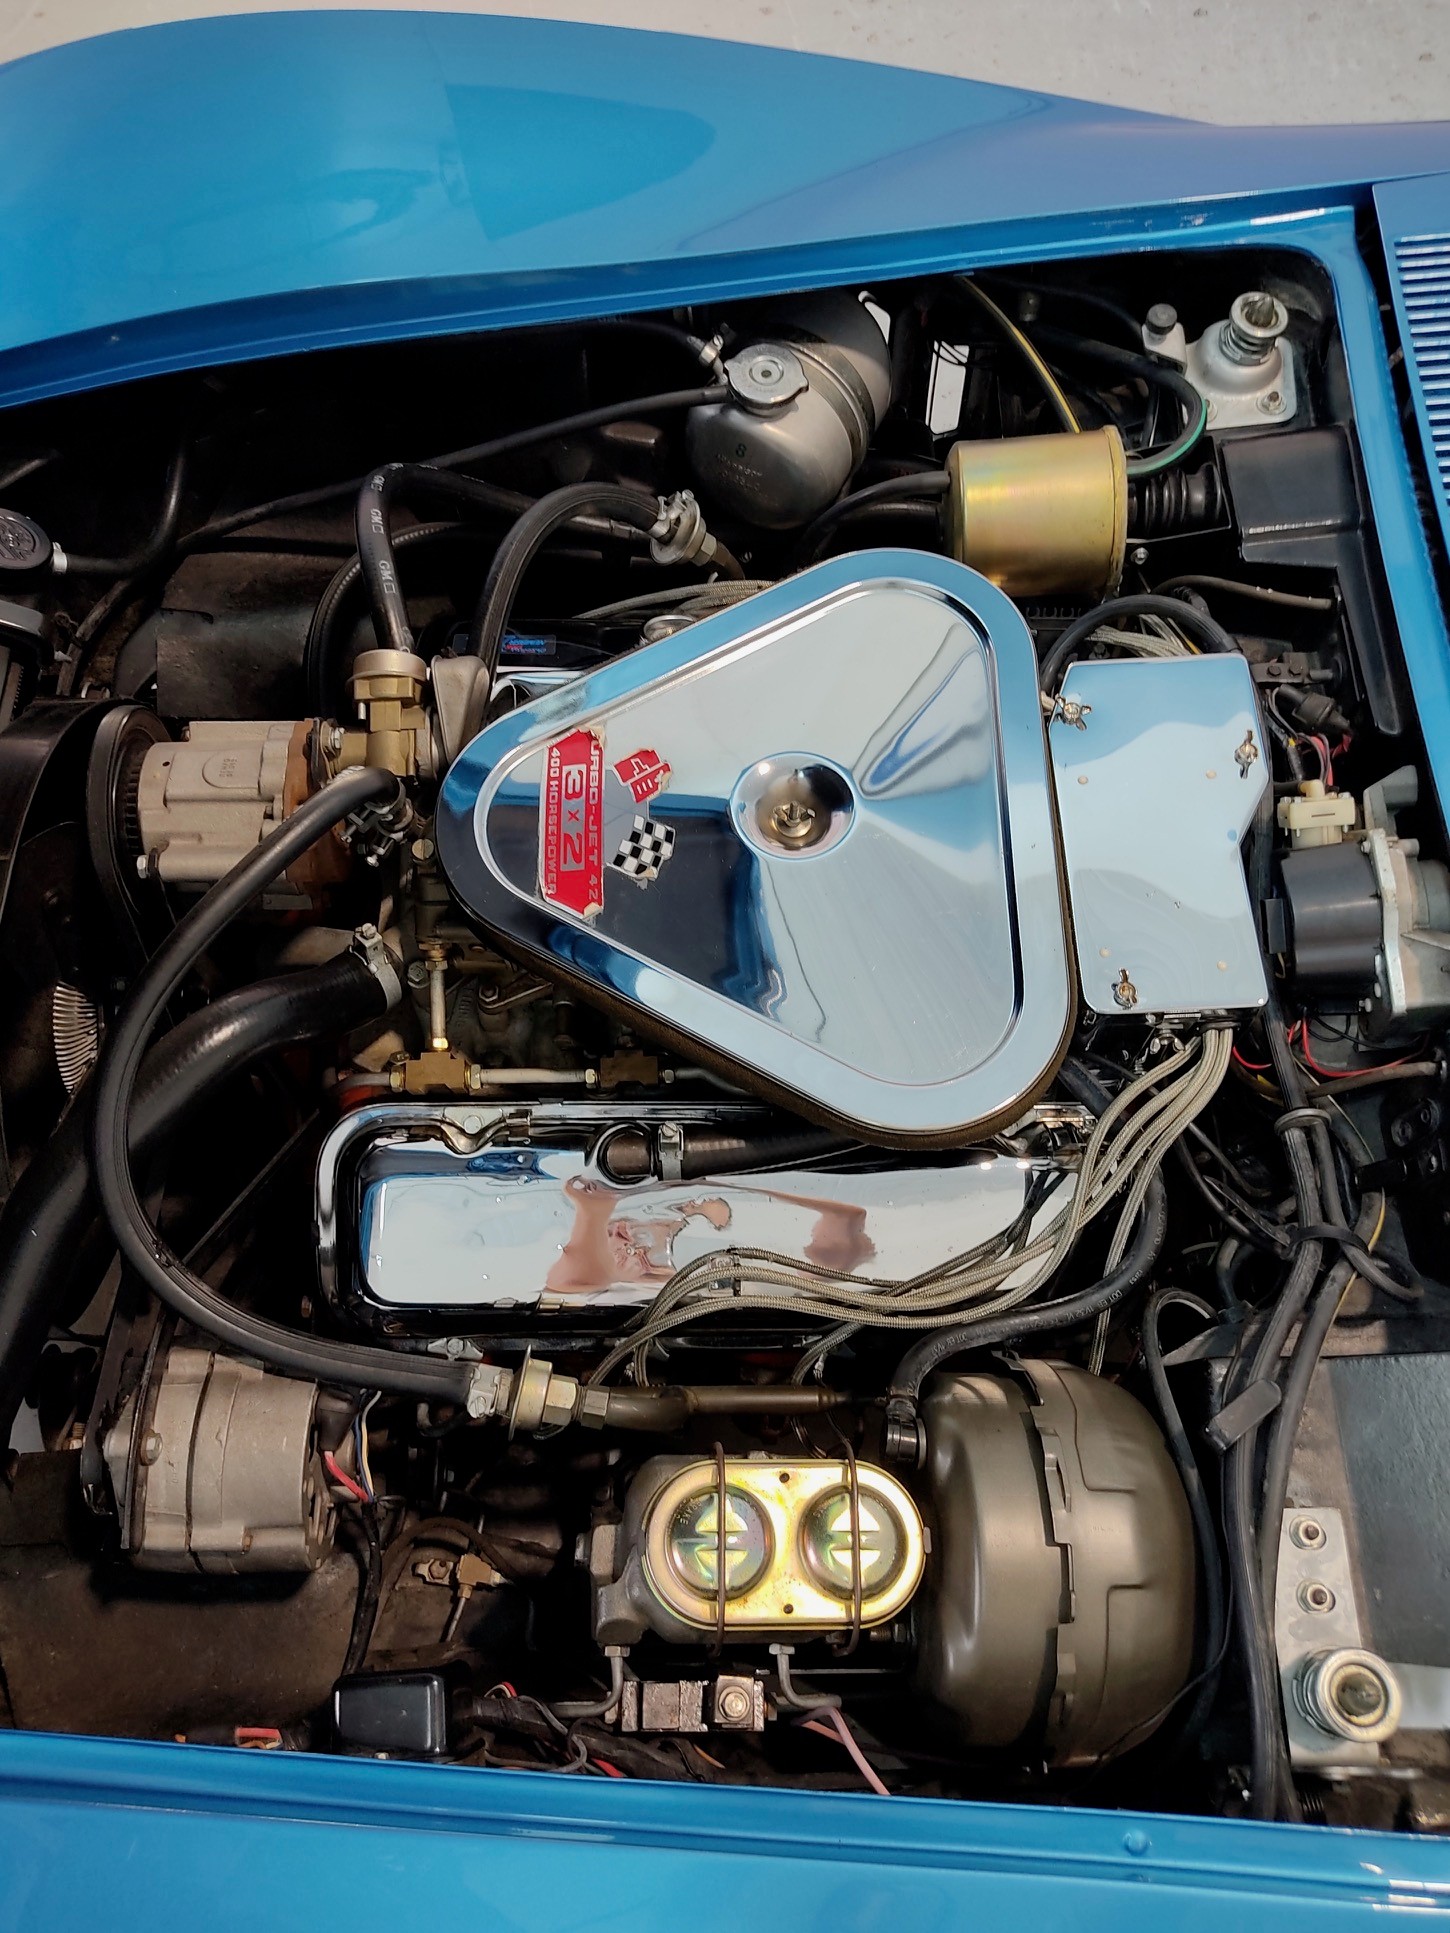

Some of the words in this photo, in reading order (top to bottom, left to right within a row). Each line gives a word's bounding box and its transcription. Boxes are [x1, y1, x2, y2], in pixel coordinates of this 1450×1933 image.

[370, 508, 382, 523] GM
[378, 560, 394, 581] GM
[551, 747, 561, 778] 400
[564, 769, 583, 800] 3
[588, 740, 599, 866] URBO-JET
[547, 780, 559, 895] HORSEPOWER
[564, 832, 582, 865] 2
[588, 873, 598, 900] 42
